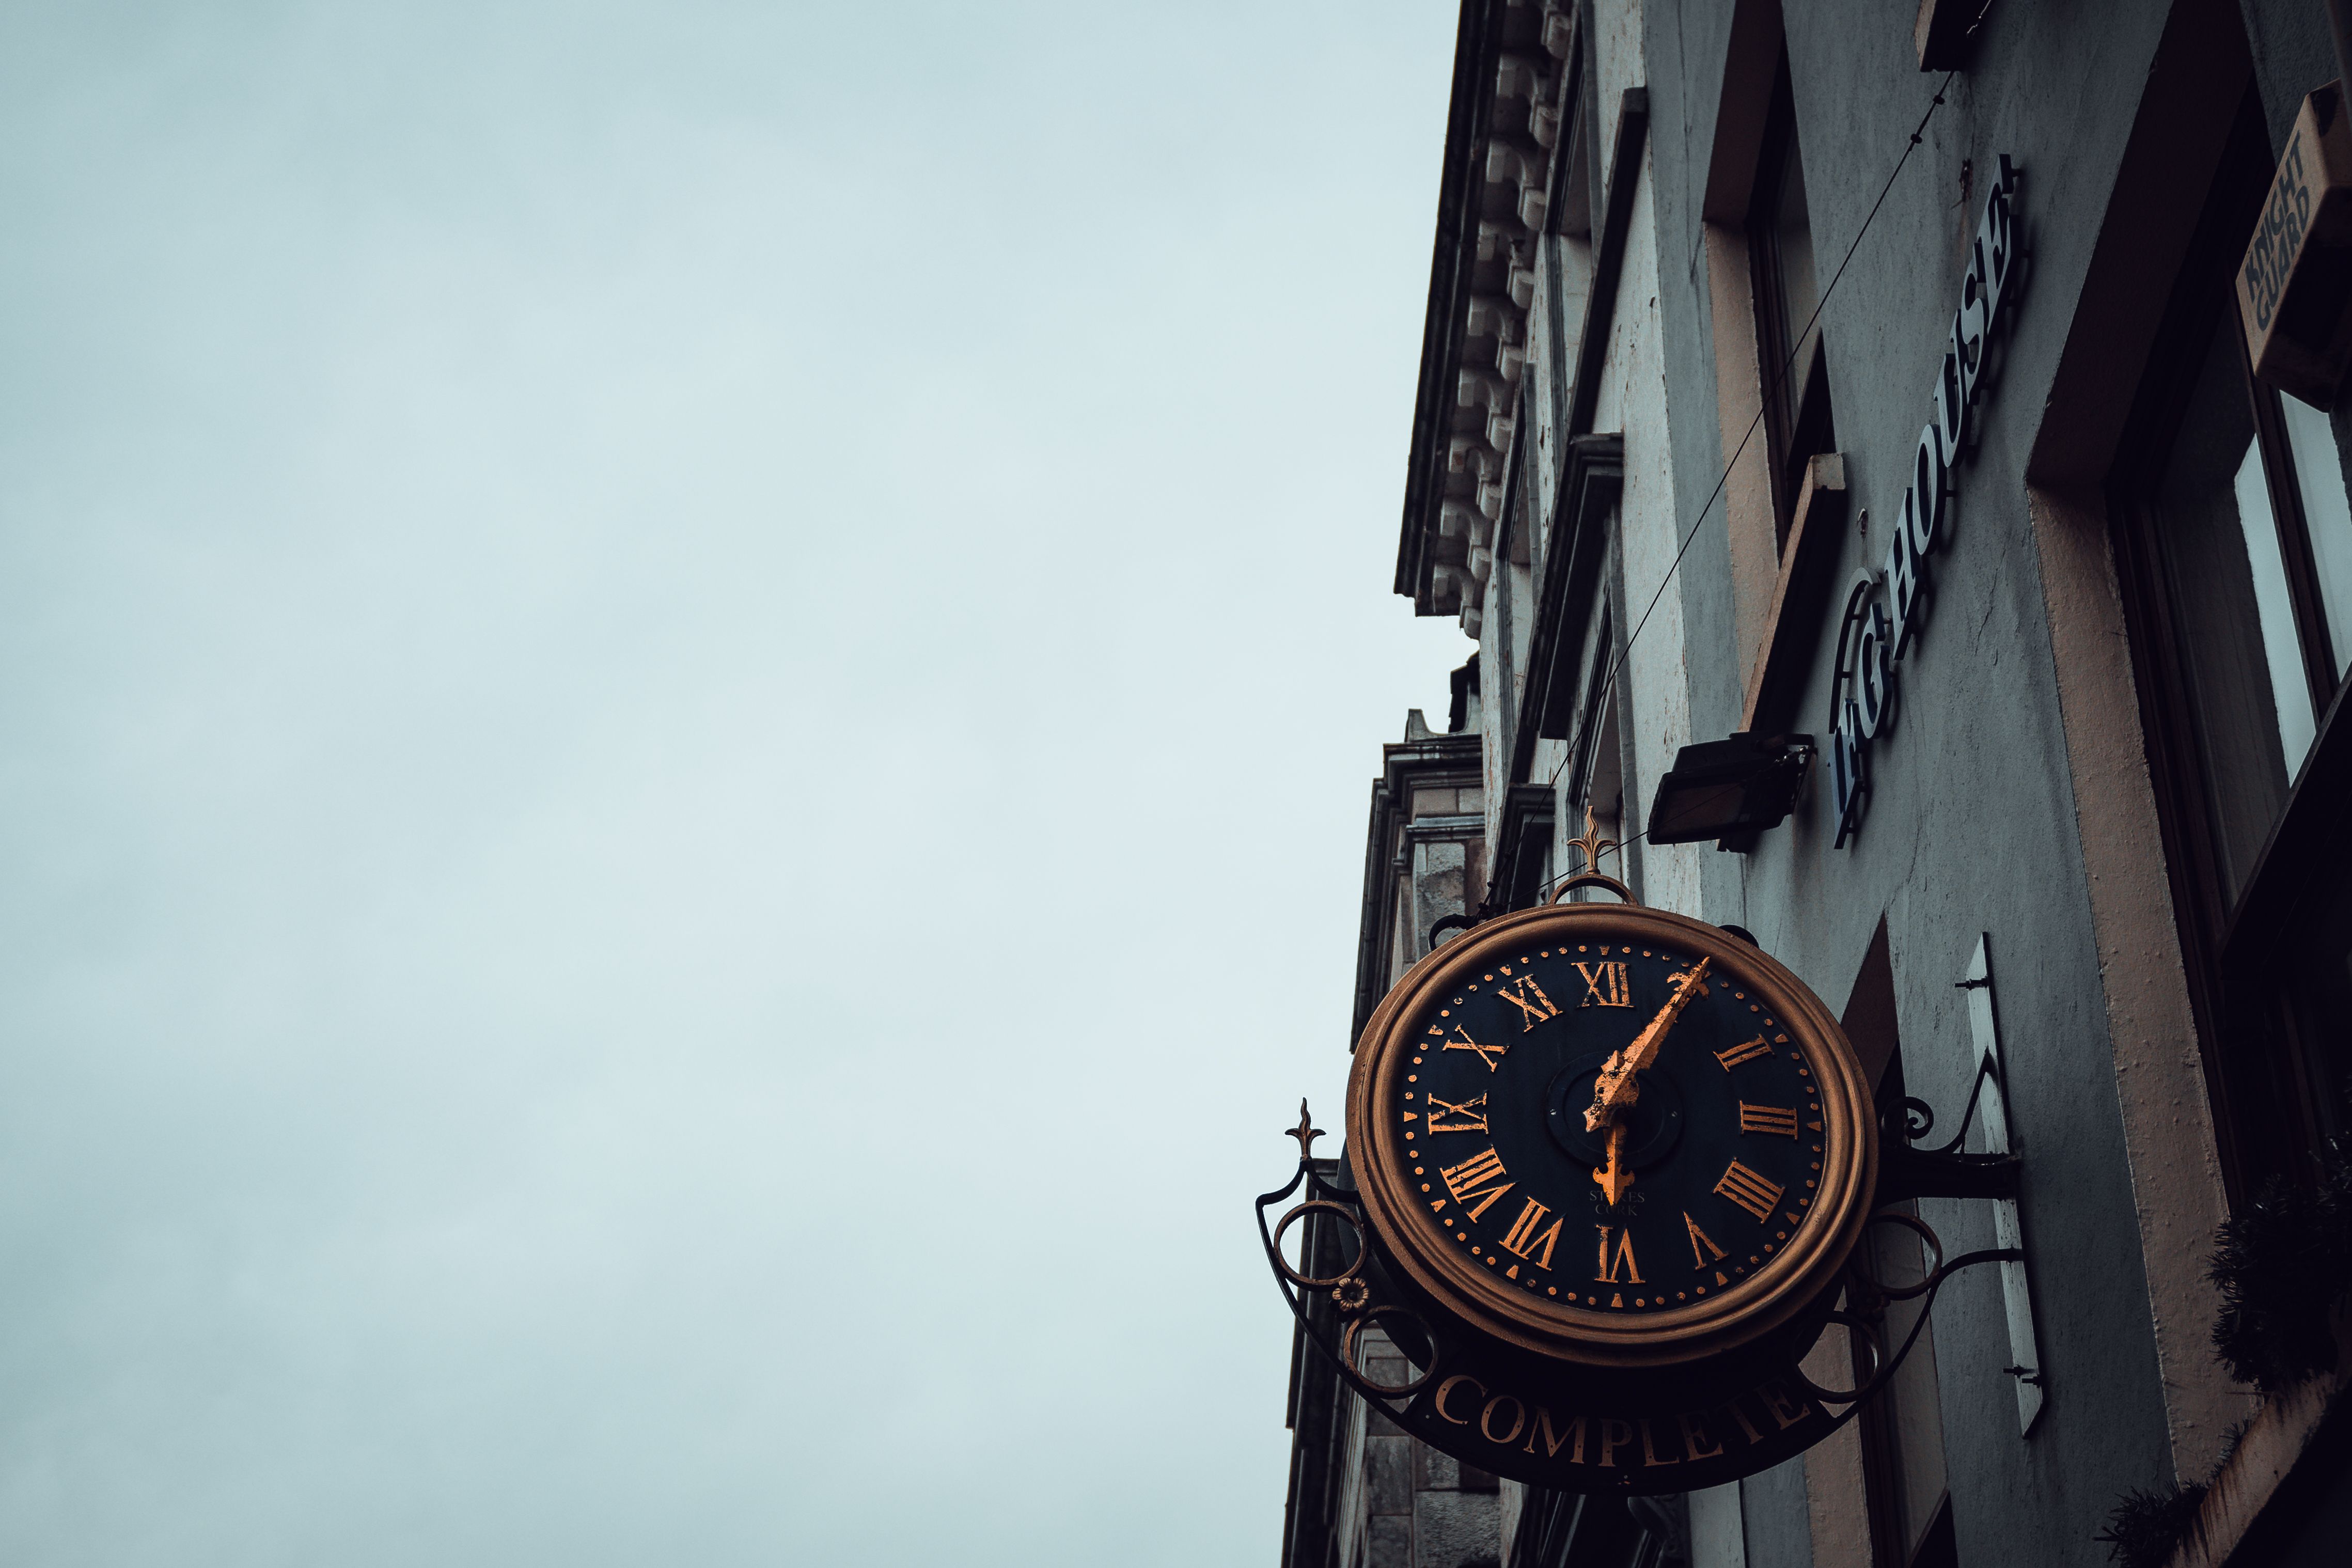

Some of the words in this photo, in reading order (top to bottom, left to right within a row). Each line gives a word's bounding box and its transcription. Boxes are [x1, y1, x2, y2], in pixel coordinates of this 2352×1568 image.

[2245, 130, 2303, 305] KNIGHT
[2256, 185, 2310, 331] GUARD
[1884, 153, 2020, 661] HOUSE
[1496, 974, 1563, 1033] XI
[1570, 961, 1636, 1008] XII
[1442, 1023, 1509, 1073] X
[1713, 1033, 1775, 1072] II
[1428, 1091, 1489, 1136] IX
[1739, 1100, 1798, 1140] III
[1439, 1143, 1518, 1224] VIII
[1590, 1190, 1645, 1203] STES
[1711, 1156, 1785, 1224] IIII
[1498, 1195, 1565, 1271] VII
[1594, 1223, 1646, 1284] VI
[1682, 1210, 1730, 1270] V
[1435, 1374, 1812, 1467] COMPLETE
